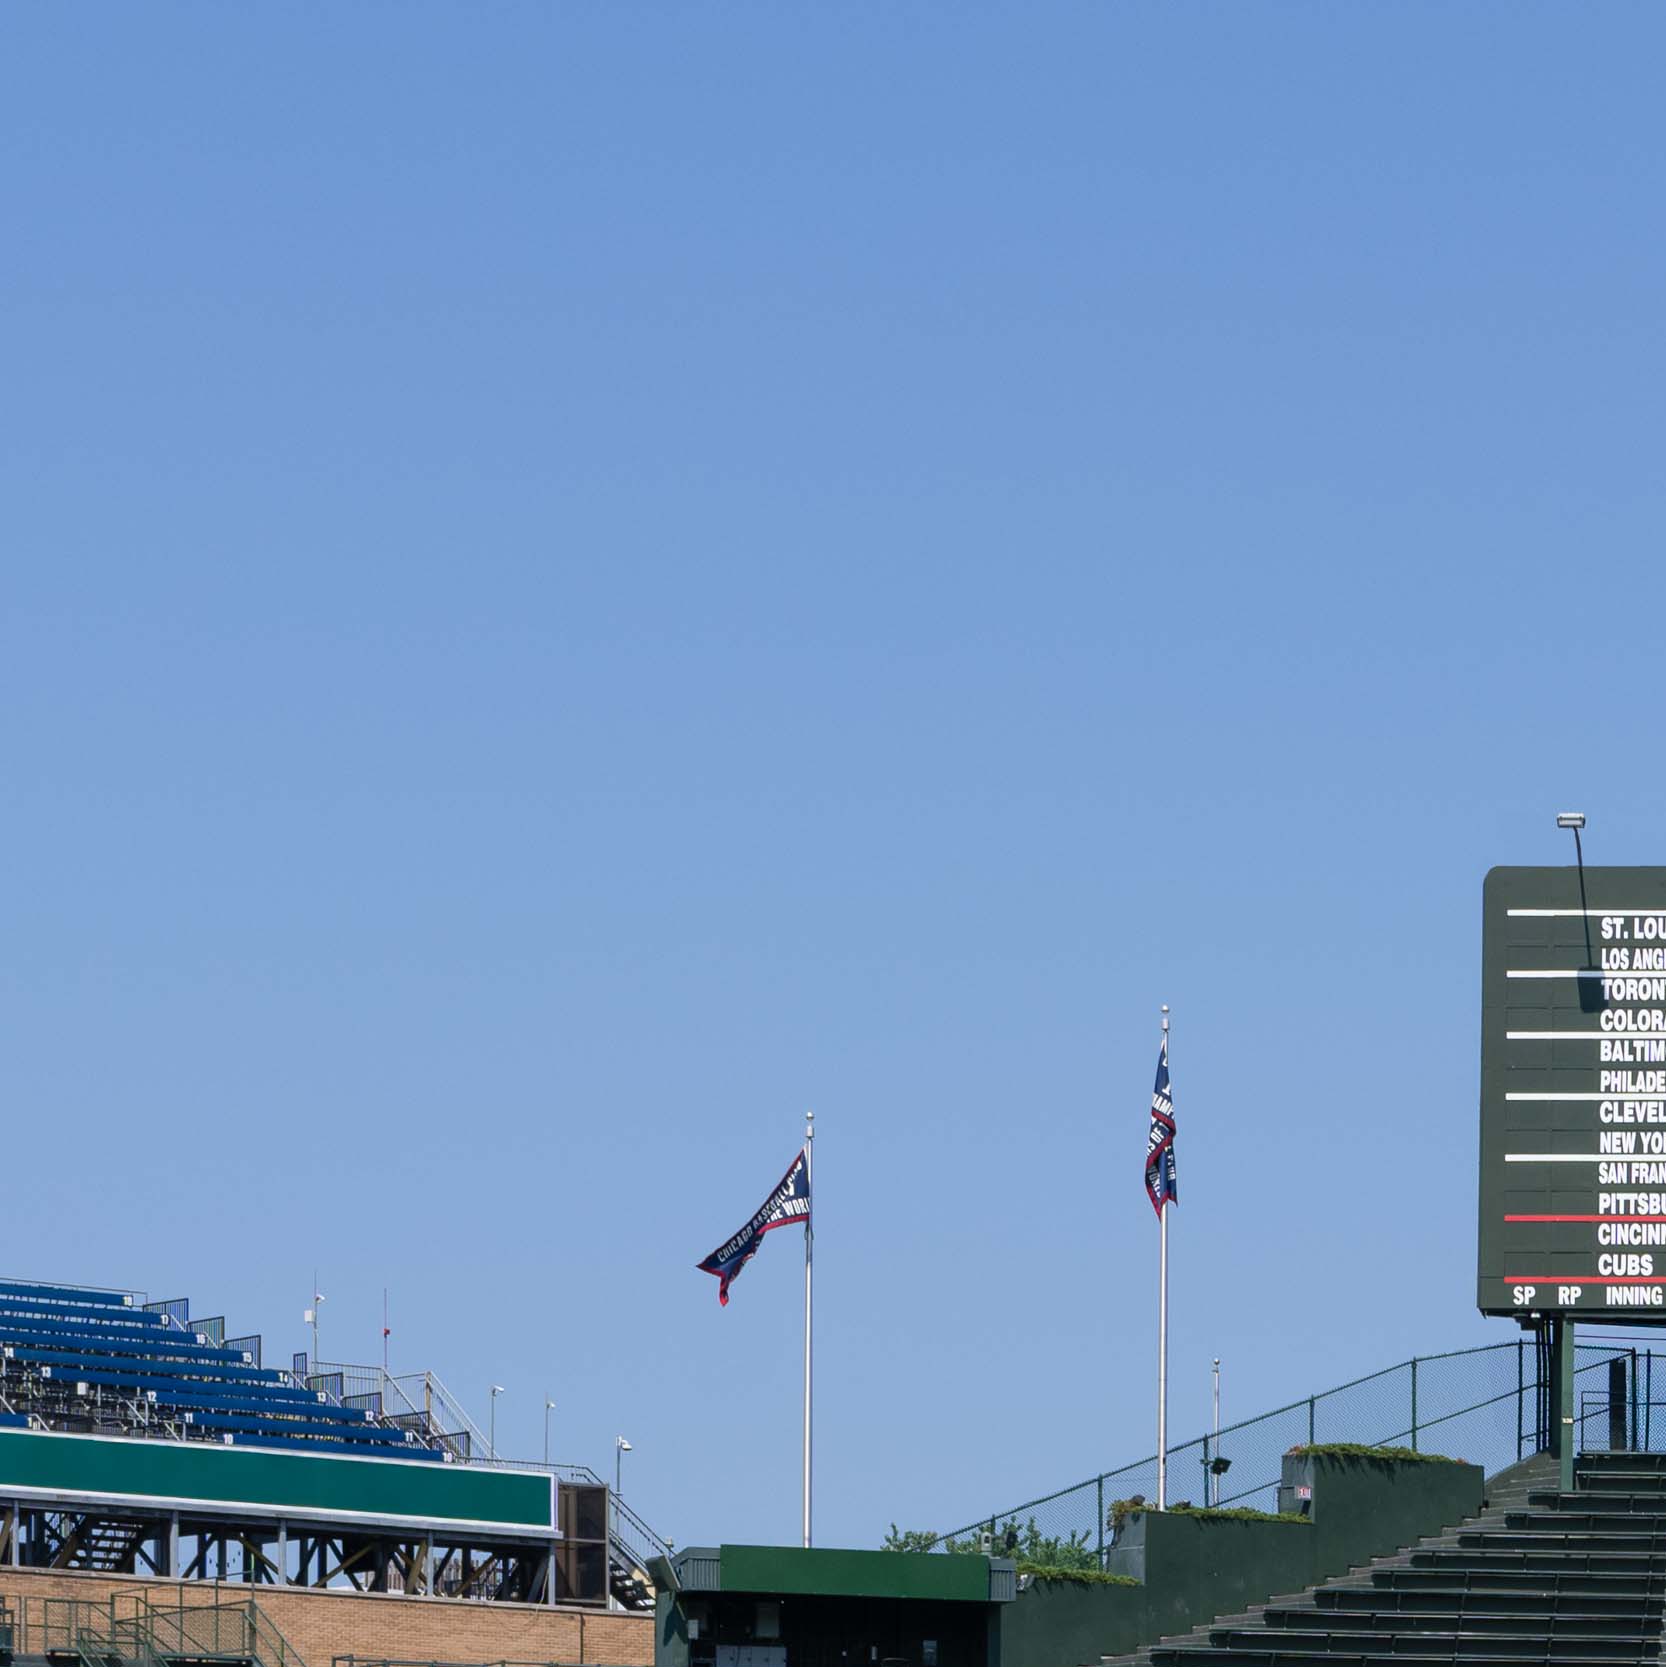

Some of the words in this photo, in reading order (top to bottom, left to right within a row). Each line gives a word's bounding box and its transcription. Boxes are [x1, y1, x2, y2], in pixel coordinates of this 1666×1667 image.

[1601, 918, 1629, 940] ST.
[1601, 948, 1629, 970] LOS
[1600, 1132, 1636, 1154] NEW
[1599, 1162, 1628, 1185] SAN
[718, 1226, 753, 1262] CHICAGO
[1598, 1254, 1653, 1276] CUBS
[1513, 1287, 1535, 1306] SP
[1558, 1287, 1582, 1306] RP
[1606, 1287, 1663, 1306] INNING
